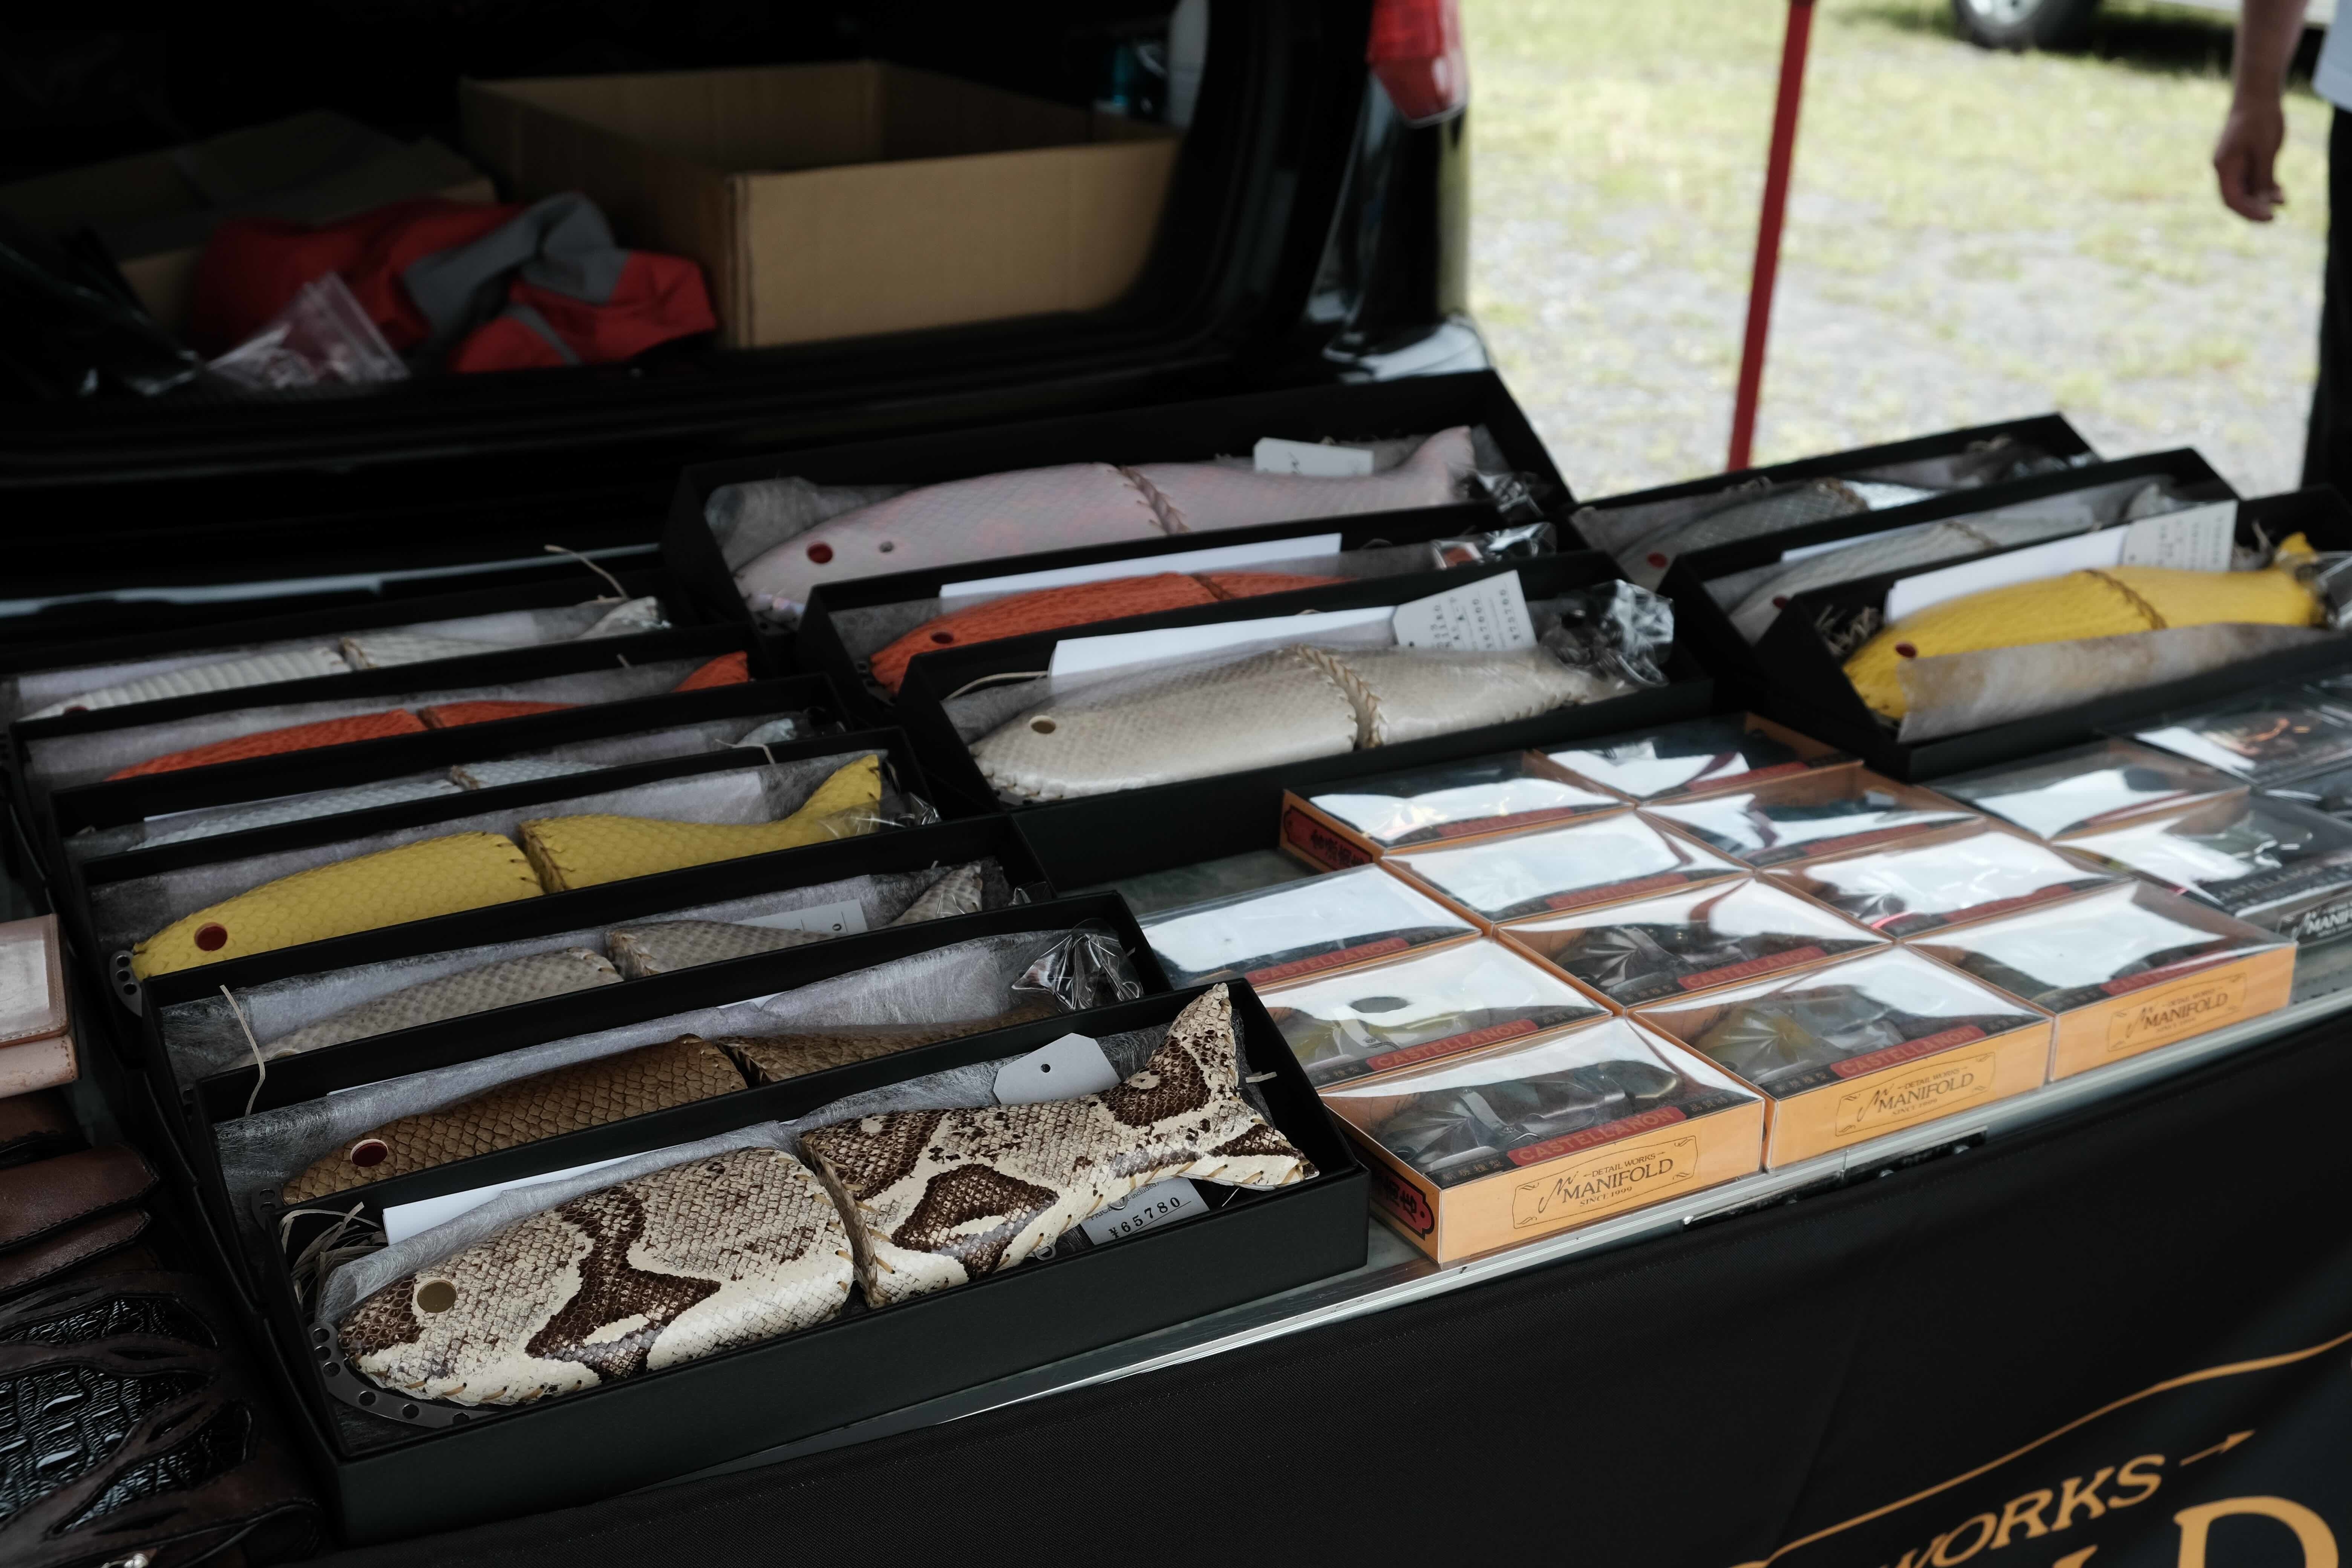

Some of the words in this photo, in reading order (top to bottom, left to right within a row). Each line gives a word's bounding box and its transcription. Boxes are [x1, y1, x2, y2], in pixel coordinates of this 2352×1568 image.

[1255, 939, 1399, 980] CASTELLANON
[1688, 947, 1814, 986] CASTELLANON
[2144, 993, 2228, 1030] MANIFOLD
[1377, 1022, 1527, 1067] CASTELLANON
[1841, 1029, 1976, 1075] CASTELLANON
[1877, 1073, 1974, 1113] MANIFOLD
[1905, 1077, 1930, 1089] DETAIL
[1519, 1111, 1674, 1161] CASTELLANON
[1562, 1158, 1674, 1204] MANIFOLD
[1592, 1163, 1623, 1177] DETAIL
[1624, 1153, 1656, 1167] WORKS
[1580, 1193, 1609, 1207] SINCE
[1611, 1186, 1632, 1197] 1999
[1109, 1197, 1181, 1239] ¥65780
